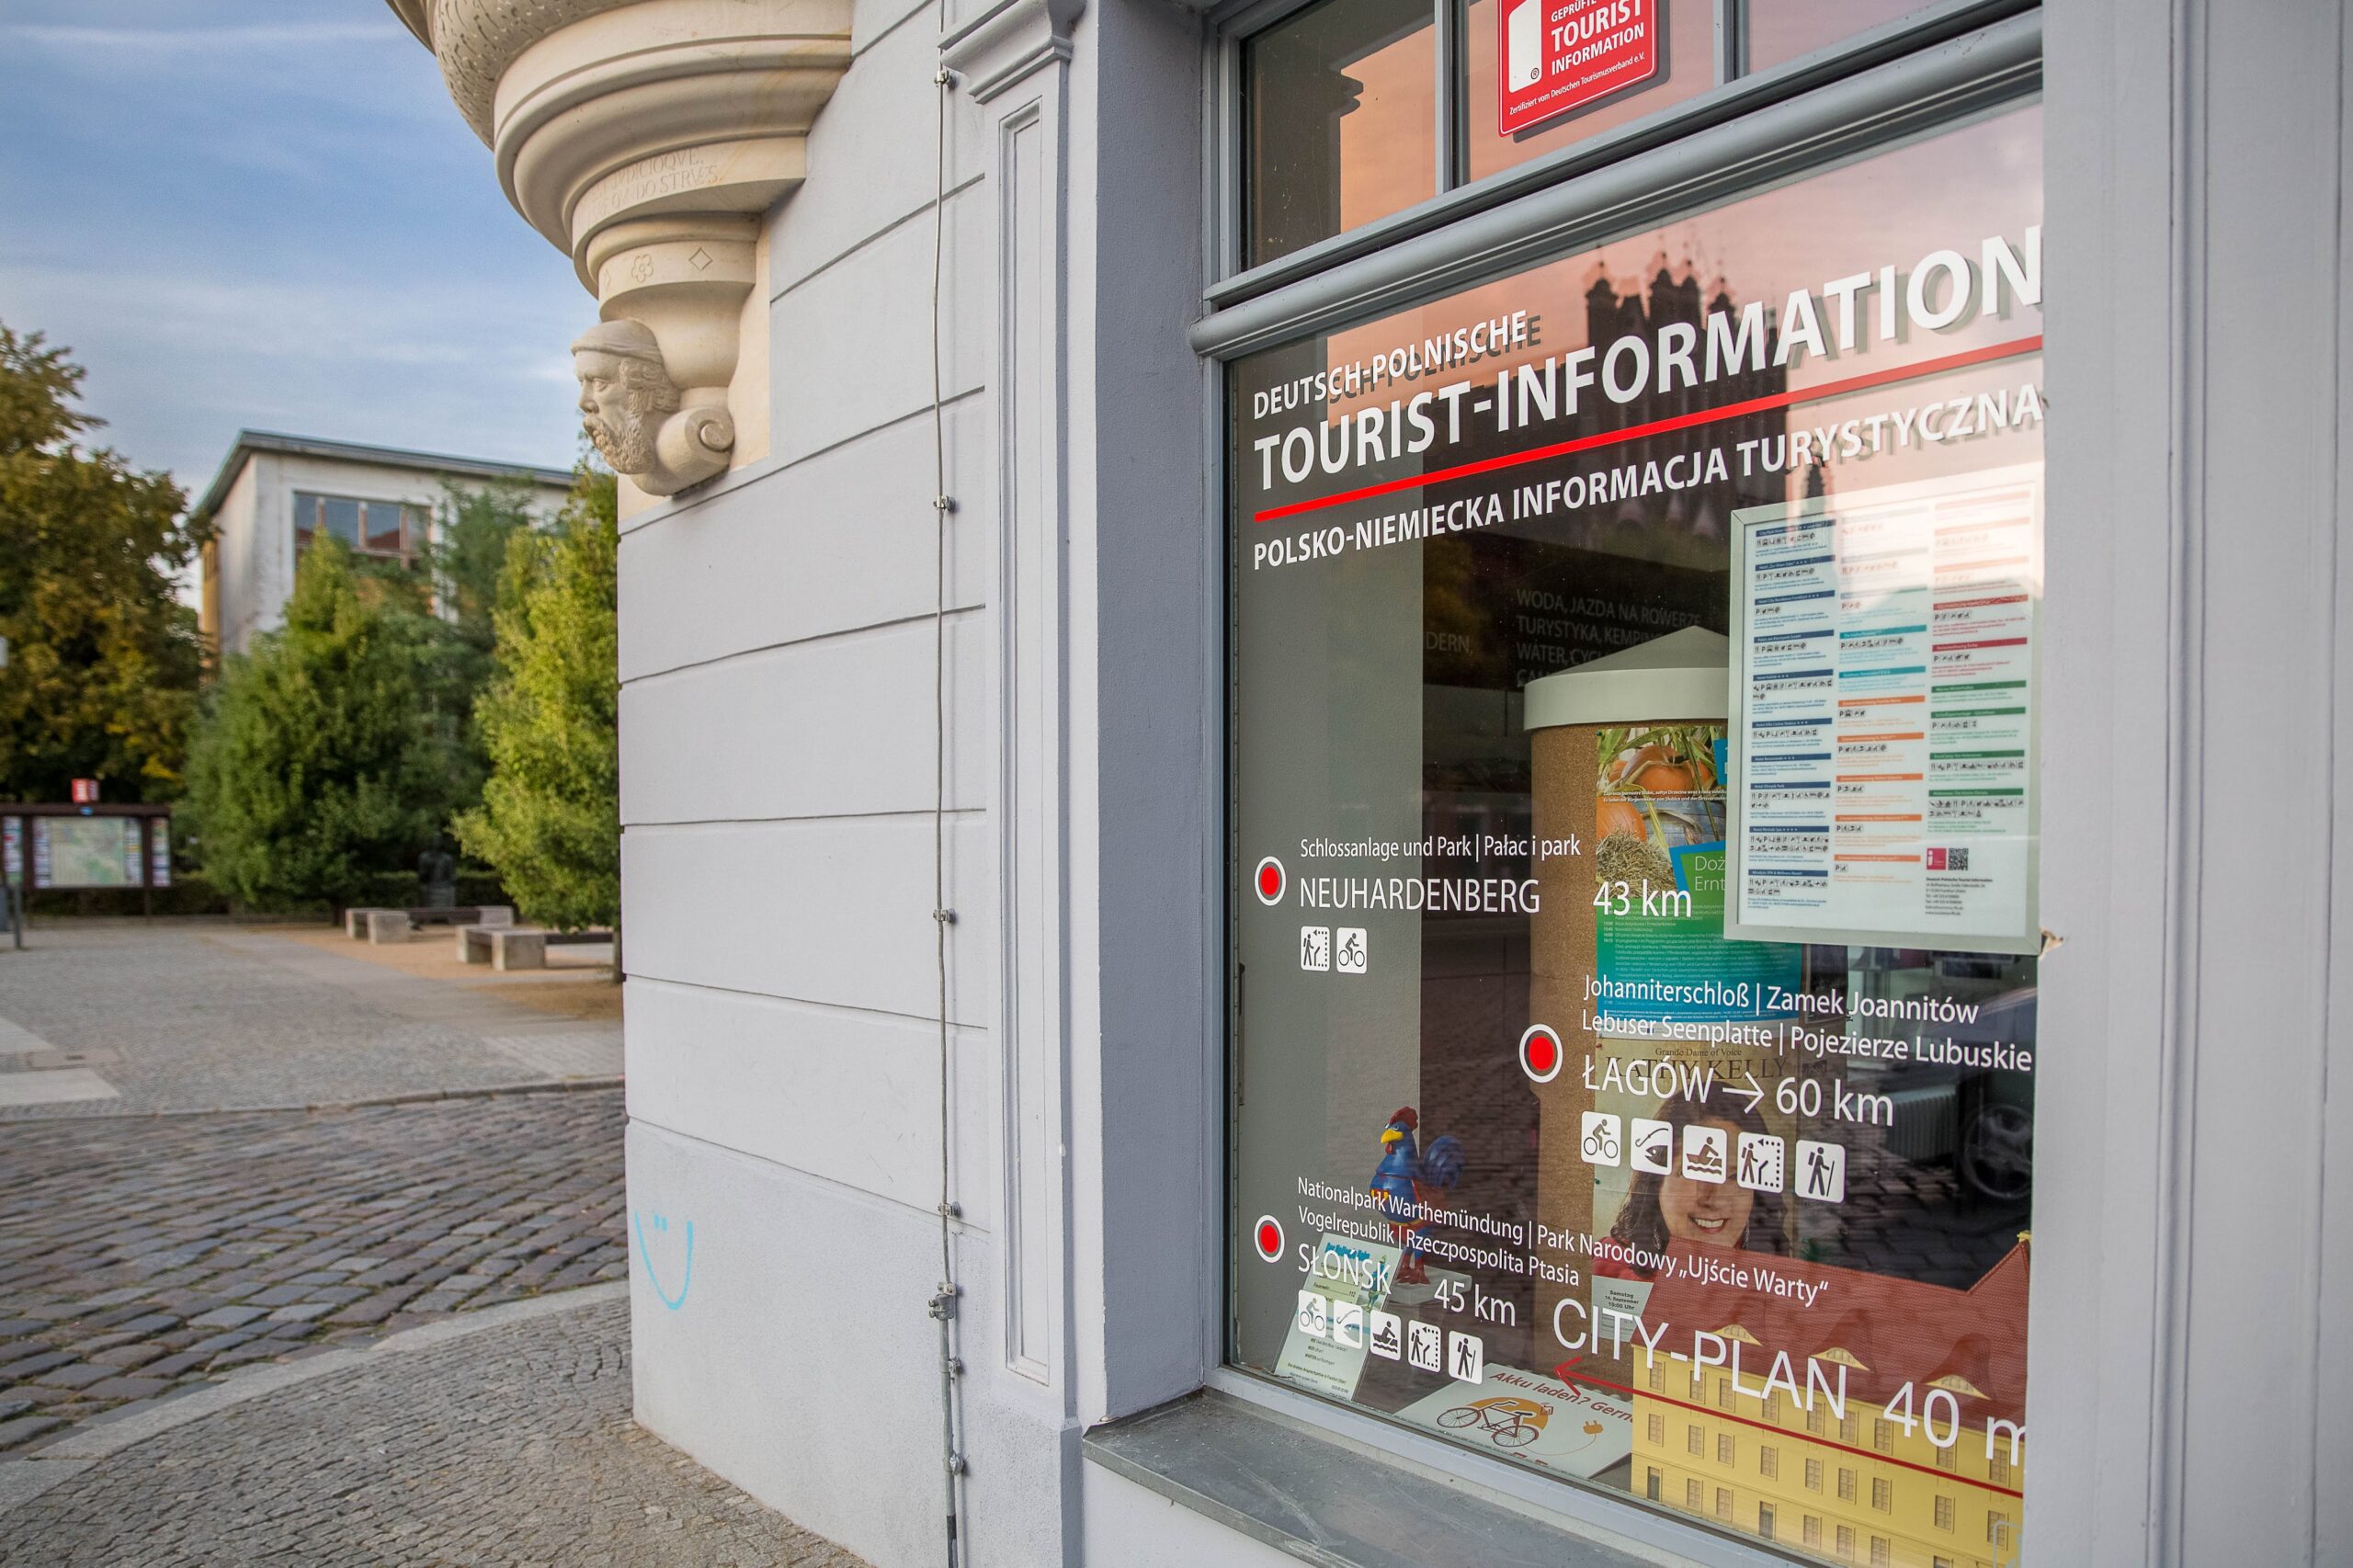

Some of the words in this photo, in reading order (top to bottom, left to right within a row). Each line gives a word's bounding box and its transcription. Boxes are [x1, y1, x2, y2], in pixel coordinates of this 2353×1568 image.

[1551, 0, 1642, 52] TOURIST
[1552, 22, 1644, 76] INFORMATION
[1509, 97, 1538, 116] Zertifiziert
[1538, 93, 1550, 105] vom
[1551, 79, 1580, 98] Deutschen
[1580, 57, 1633, 85] Tourismusverband
[1633, 51, 1645, 63] e.V.
[1254, 225, 2041, 490] TOURIST-INFORMATION
[1254, 310, 1527, 420] DEUTSCH-POLNISCHE
[1254, 494, 1505, 570] POLSKO-NIEMIECKA
[1513, 448, 1728, 521] INFORMACJA
[1735, 383, 2043, 477] TURYSTYCZNA
[1515, 615, 1602, 645] TURYSTYKA,
[1516, 587, 1568, 613] WODA,
[1569, 597, 1616, 619] JAZDA
[1619, 602, 1639, 622] NA
[1516, 642, 1568, 665] WATER,
[1300, 836, 1399, 862] Schlossanlage
[1404, 835, 1433, 858] und
[1437, 835, 1472, 858] Park
[1483, 834, 1528, 857] Pałac
[1531, 835, 1537, 857] i
[1540, 834, 1581, 865] park
[1300, 878, 1540, 914] NEUHARDENBERG
[1593, 881, 1631, 916] 43
[1642, 879, 1692, 918] km
[1584, 974, 1750, 1008] Johanniterschloß
[1767, 986, 1845, 1016] Zamek
[1849, 991, 1980, 1025] Joannitów
[1582, 1008, 1657, 1037] Lebuser
[1661, 1016, 1773, 1049] Seenplatte
[1790, 1026, 1908, 1060] Pojezierze
[1915, 1036, 2033, 1072] Lubuskie
[1655, 1047, 1685, 1057] Grande
[1686, 1048, 1708, 1057] Dame
[1710, 1047, 1719, 1057] of
[1721, 1048, 1743, 1057] Voice
[1581, 1054, 1715, 1105] ŁAGÓW
[1776, 1076, 1822, 1118] 60
[1834, 1078, 1894, 1127] km
[1706, 1057, 1790, 1080] KELLY
[1298, 1176, 1386, 1212] Nationalpark
[1389, 1194, 1523, 1245] Warthemündung
[1537, 1224, 1575, 1253] Park
[1579, 1234, 1677, 1278] Narodowy
[1679, 1256, 1749, 1290] „Ujście
[1298, 1205, 1395, 1245] Vogelrepublik
[1406, 1230, 1525, 1274] Rzeczpospolita
[1529, 1256, 1580, 1287] Ptasia
[1298, 1243, 1392, 1295] SŁOŃSK
[1434, 1278, 1465, 1313] 45
[1474, 1284, 1517, 1327] km
[1609, 1290, 1634, 1299] Samstag
[1612, 1296, 1639, 1304] September
[1489, 1372, 1534, 1389] Akku
[1533, 1382, 1591, 1405] laden?
[1552, 1298, 1847, 1421] CITY-PLAN
[1883, 1381, 1961, 1449] 40
